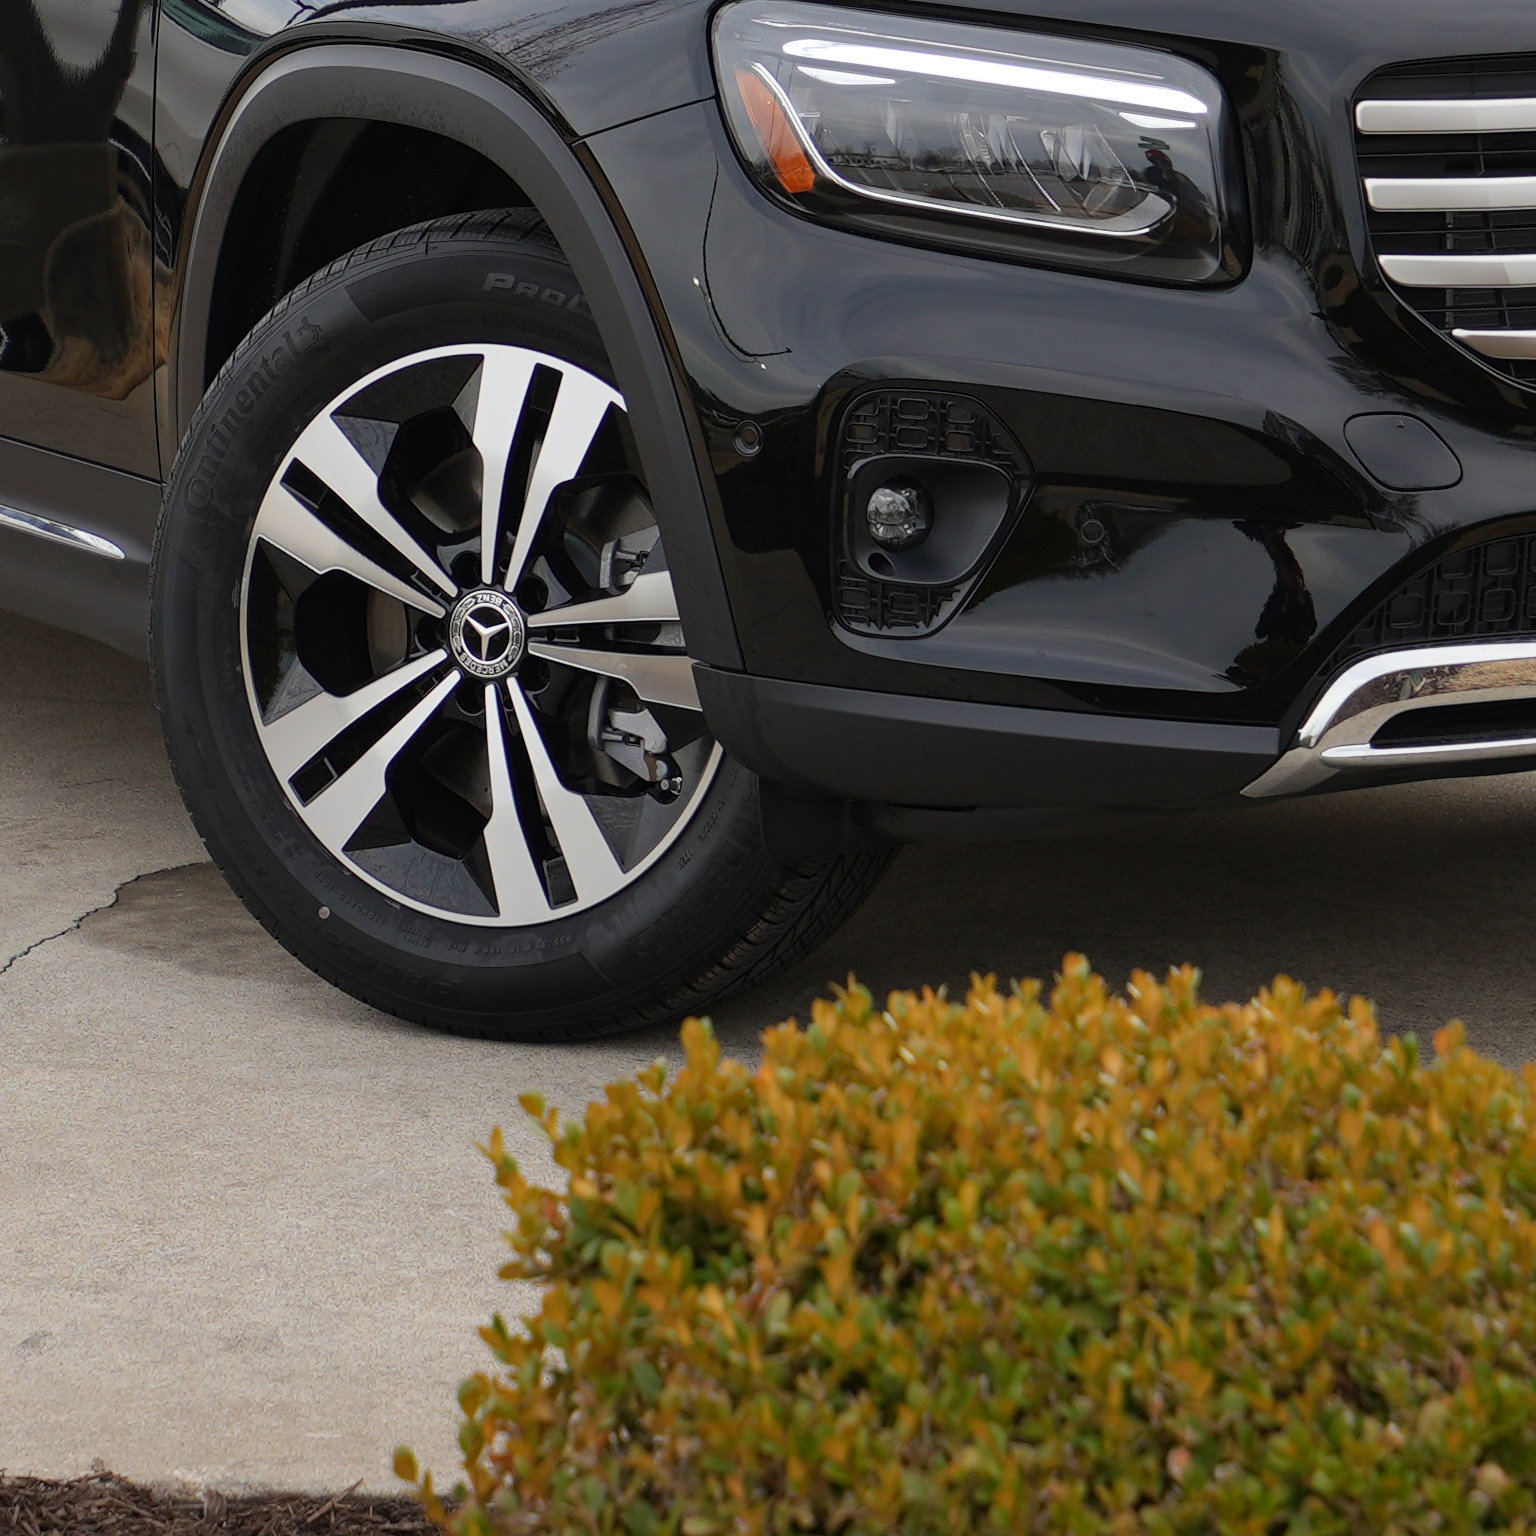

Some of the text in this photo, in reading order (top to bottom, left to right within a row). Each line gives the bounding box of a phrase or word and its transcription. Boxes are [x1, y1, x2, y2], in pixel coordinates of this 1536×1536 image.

[184, 330, 304, 518] Continental
[476, 594, 503, 605] BENZ
[459, 652, 509, 675] MERCEDES
